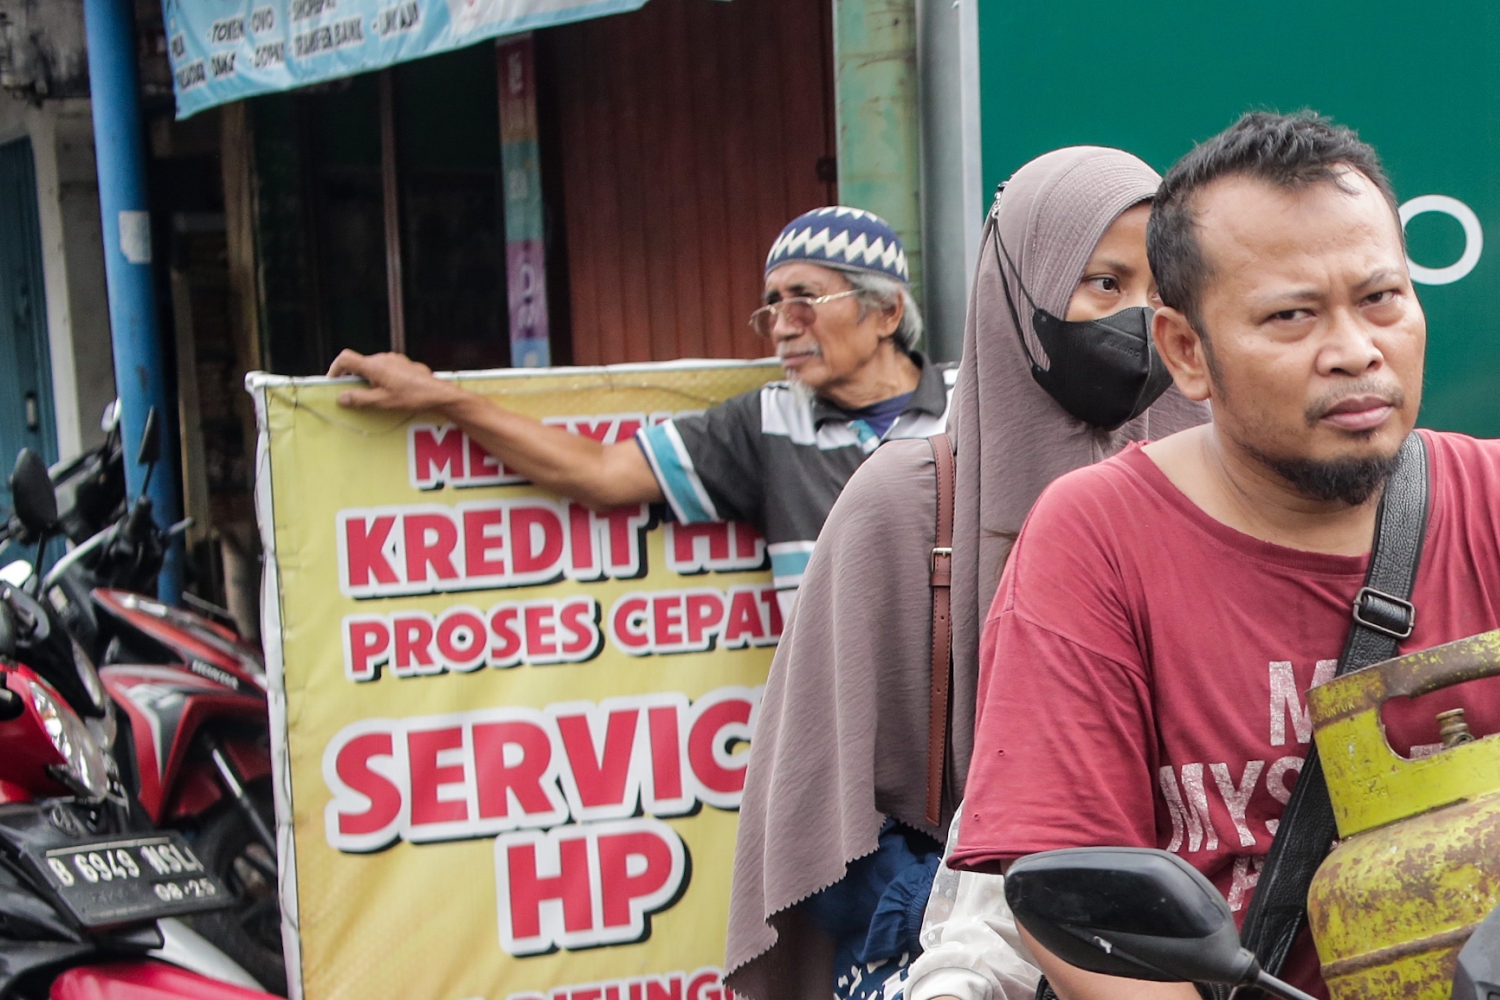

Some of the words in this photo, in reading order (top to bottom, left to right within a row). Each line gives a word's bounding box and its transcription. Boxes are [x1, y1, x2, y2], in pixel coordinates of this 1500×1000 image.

[341, 501, 646, 588] KREDIT
[347, 600, 596, 674] PROSES
[332, 697, 752, 837] SERVIC
[47, 856, 75, 887] B
[74, 848, 141, 883] 6949
[504, 829, 675, 941] HP
